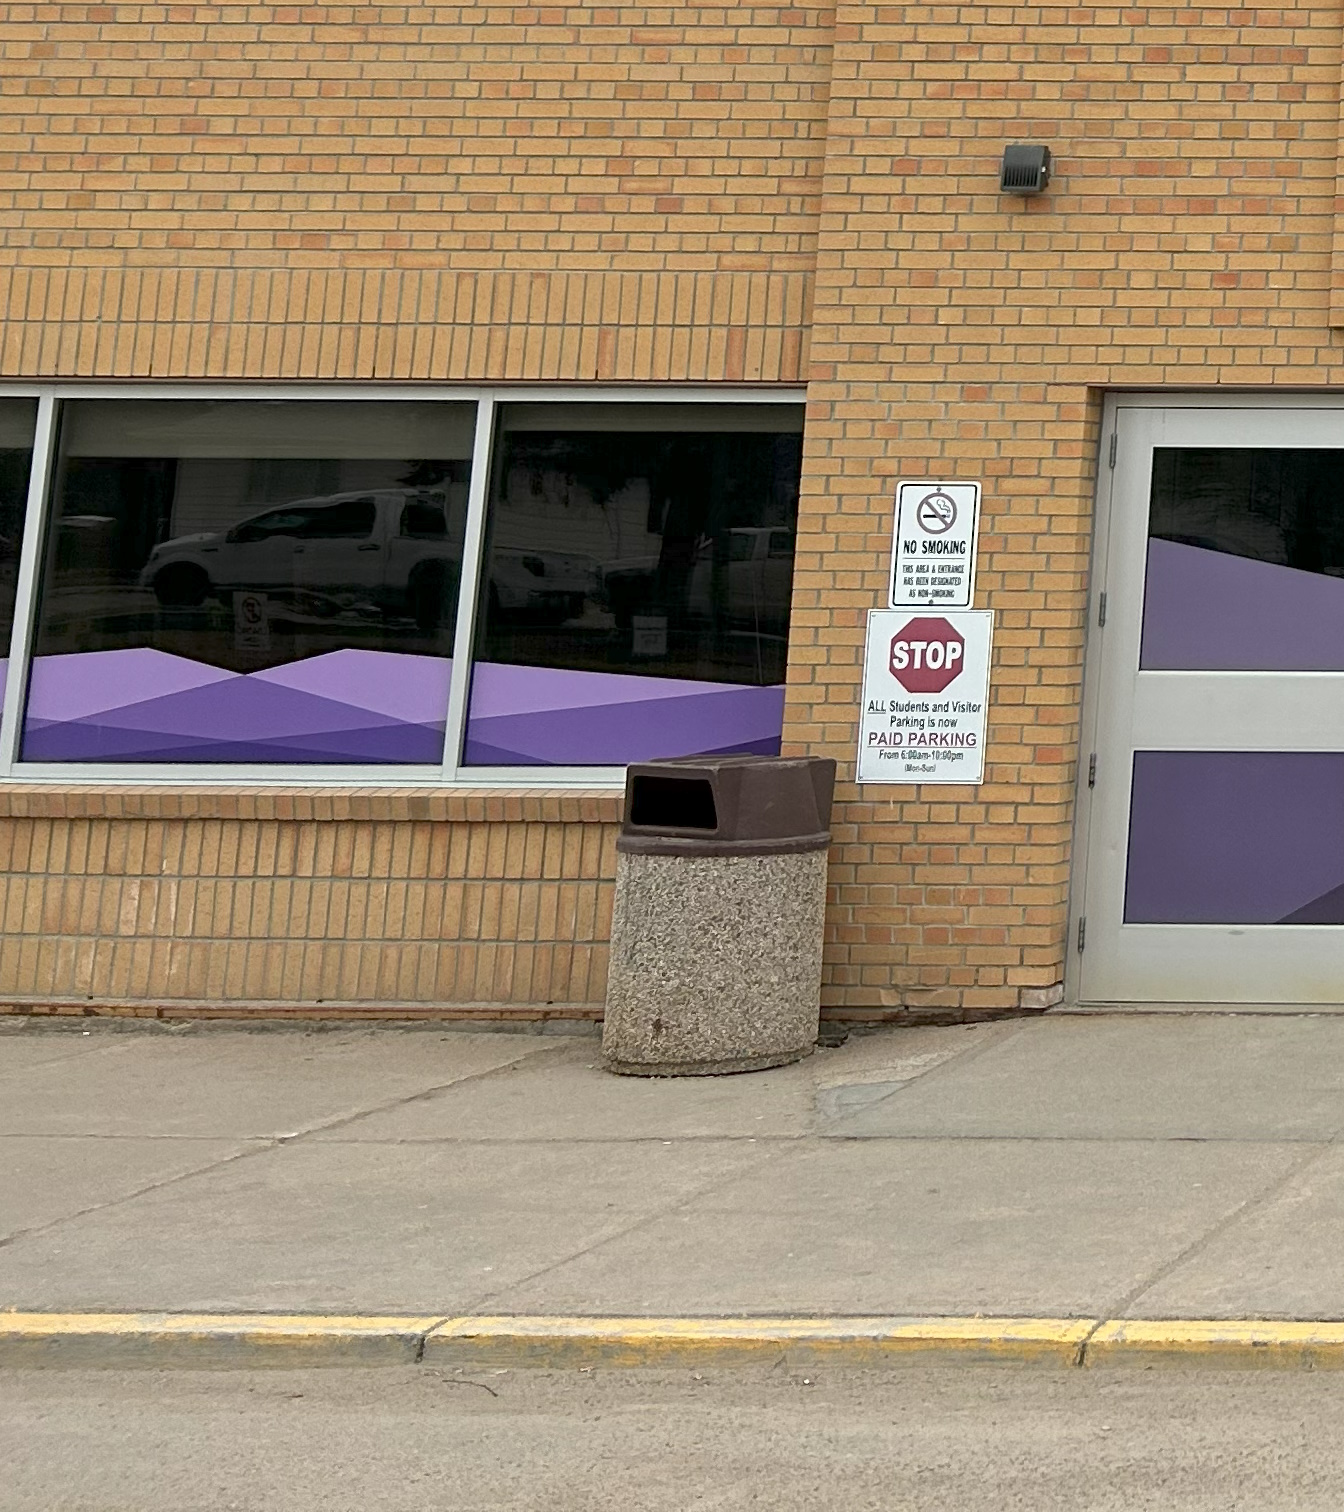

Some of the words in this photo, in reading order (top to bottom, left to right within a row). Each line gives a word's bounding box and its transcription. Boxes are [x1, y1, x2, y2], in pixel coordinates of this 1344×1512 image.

[903, 539, 917, 554] NO
[921, 540, 966, 554] SMOKING
[902, 565, 914, 573] THIS
[915, 565, 930, 573] AREA
[931, 565, 936, 573] &
[937, 565, 965, 573] ENTRANCE
[903, 577, 914, 586] HAS
[915, 577, 930, 586] BEEN
[930, 577, 962, 586] DESIGNATED
[909, 589, 916, 598] AS
[917, 589, 955, 598] NON-SMOKING
[892, 640, 962, 670] STOP
[867, 700, 886, 712] ALL
[889, 700, 930, 713] Students
[932, 701, 950, 713] and
[952, 701, 982, 713] Visitor
[890, 715, 925, 730] Parking
[928, 716, 936, 728] is
[938, 718, 958, 728] now
[868, 732, 903, 745] PAID
[907, 732, 977, 747] PARKING
[879, 749, 899, 760] From
